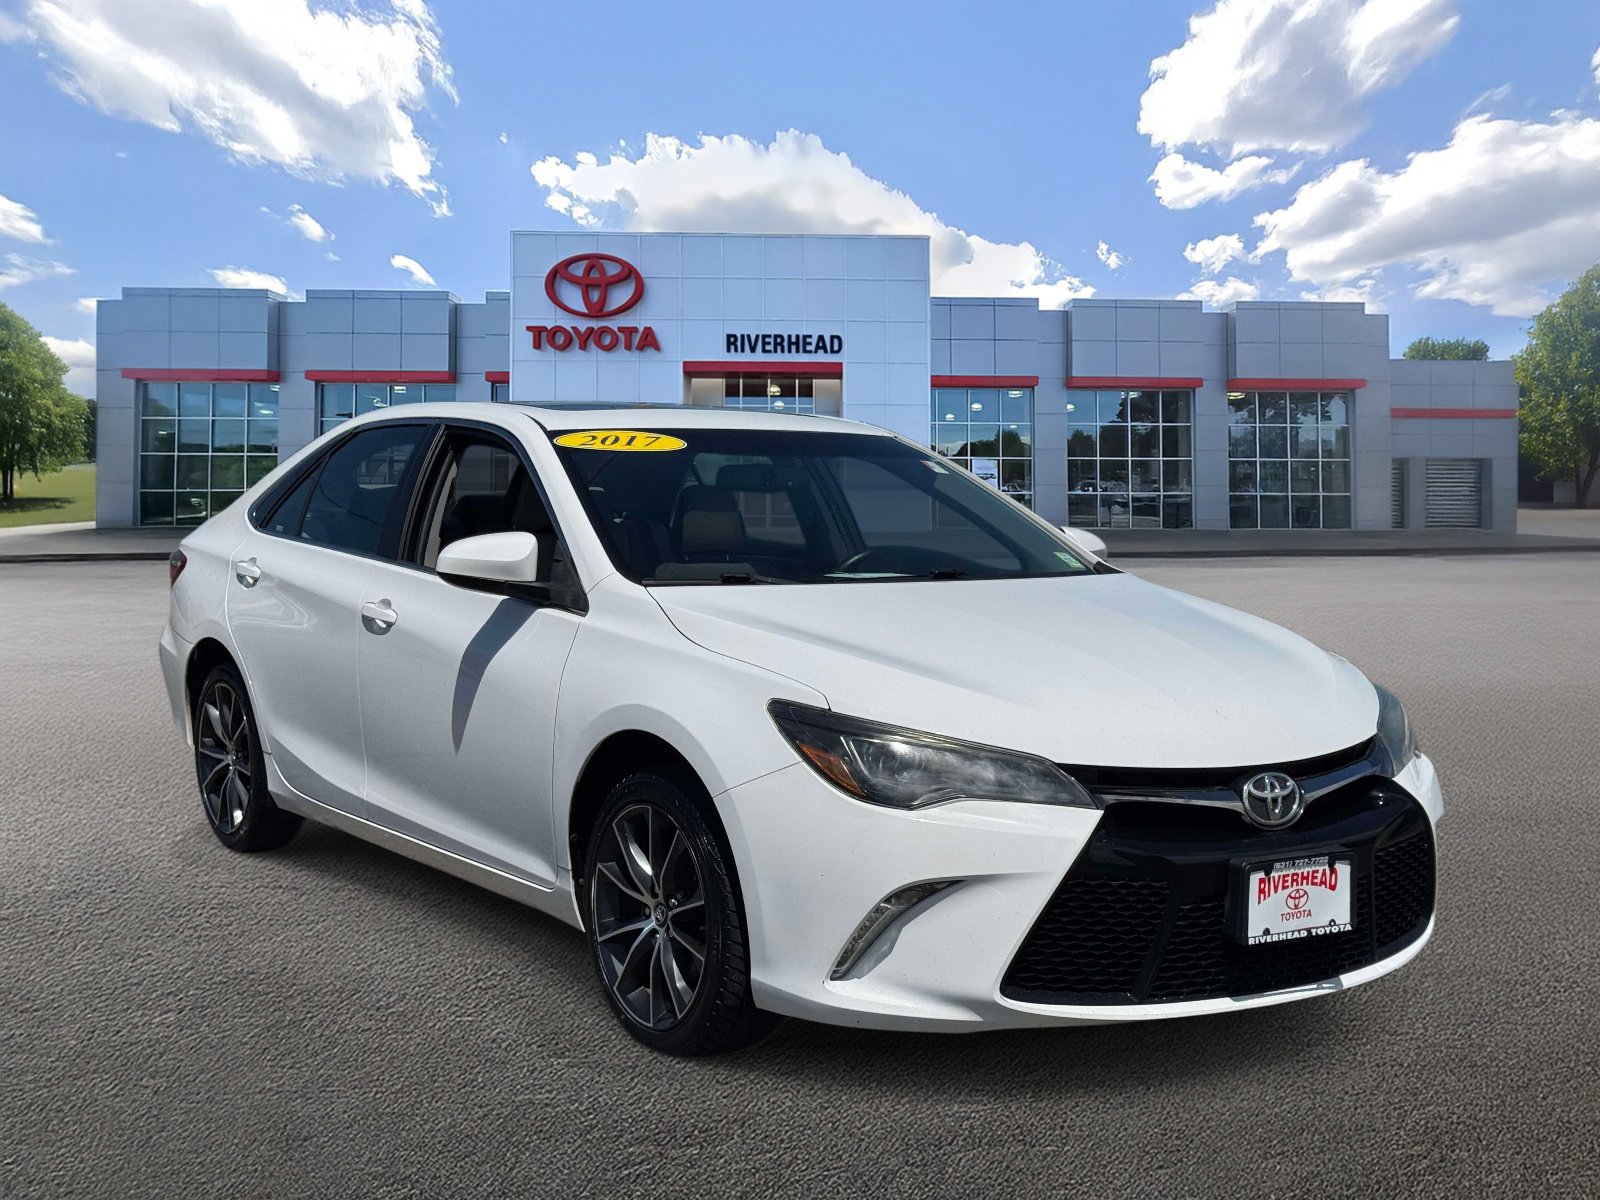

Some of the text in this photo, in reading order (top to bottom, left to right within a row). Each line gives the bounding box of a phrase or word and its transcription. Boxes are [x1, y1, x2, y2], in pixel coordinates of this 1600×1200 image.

[526, 326, 661, 351] TOYOTA
[726, 333, 843, 354] RIVERHEAD
[580, 435, 661, 446] 2017
[1258, 867, 1338, 905] RIVERHEAD
[1281, 909, 1312, 922] TOYOTA
[1248, 923, 1352, 945] RIVERHEAD TOYOTA
